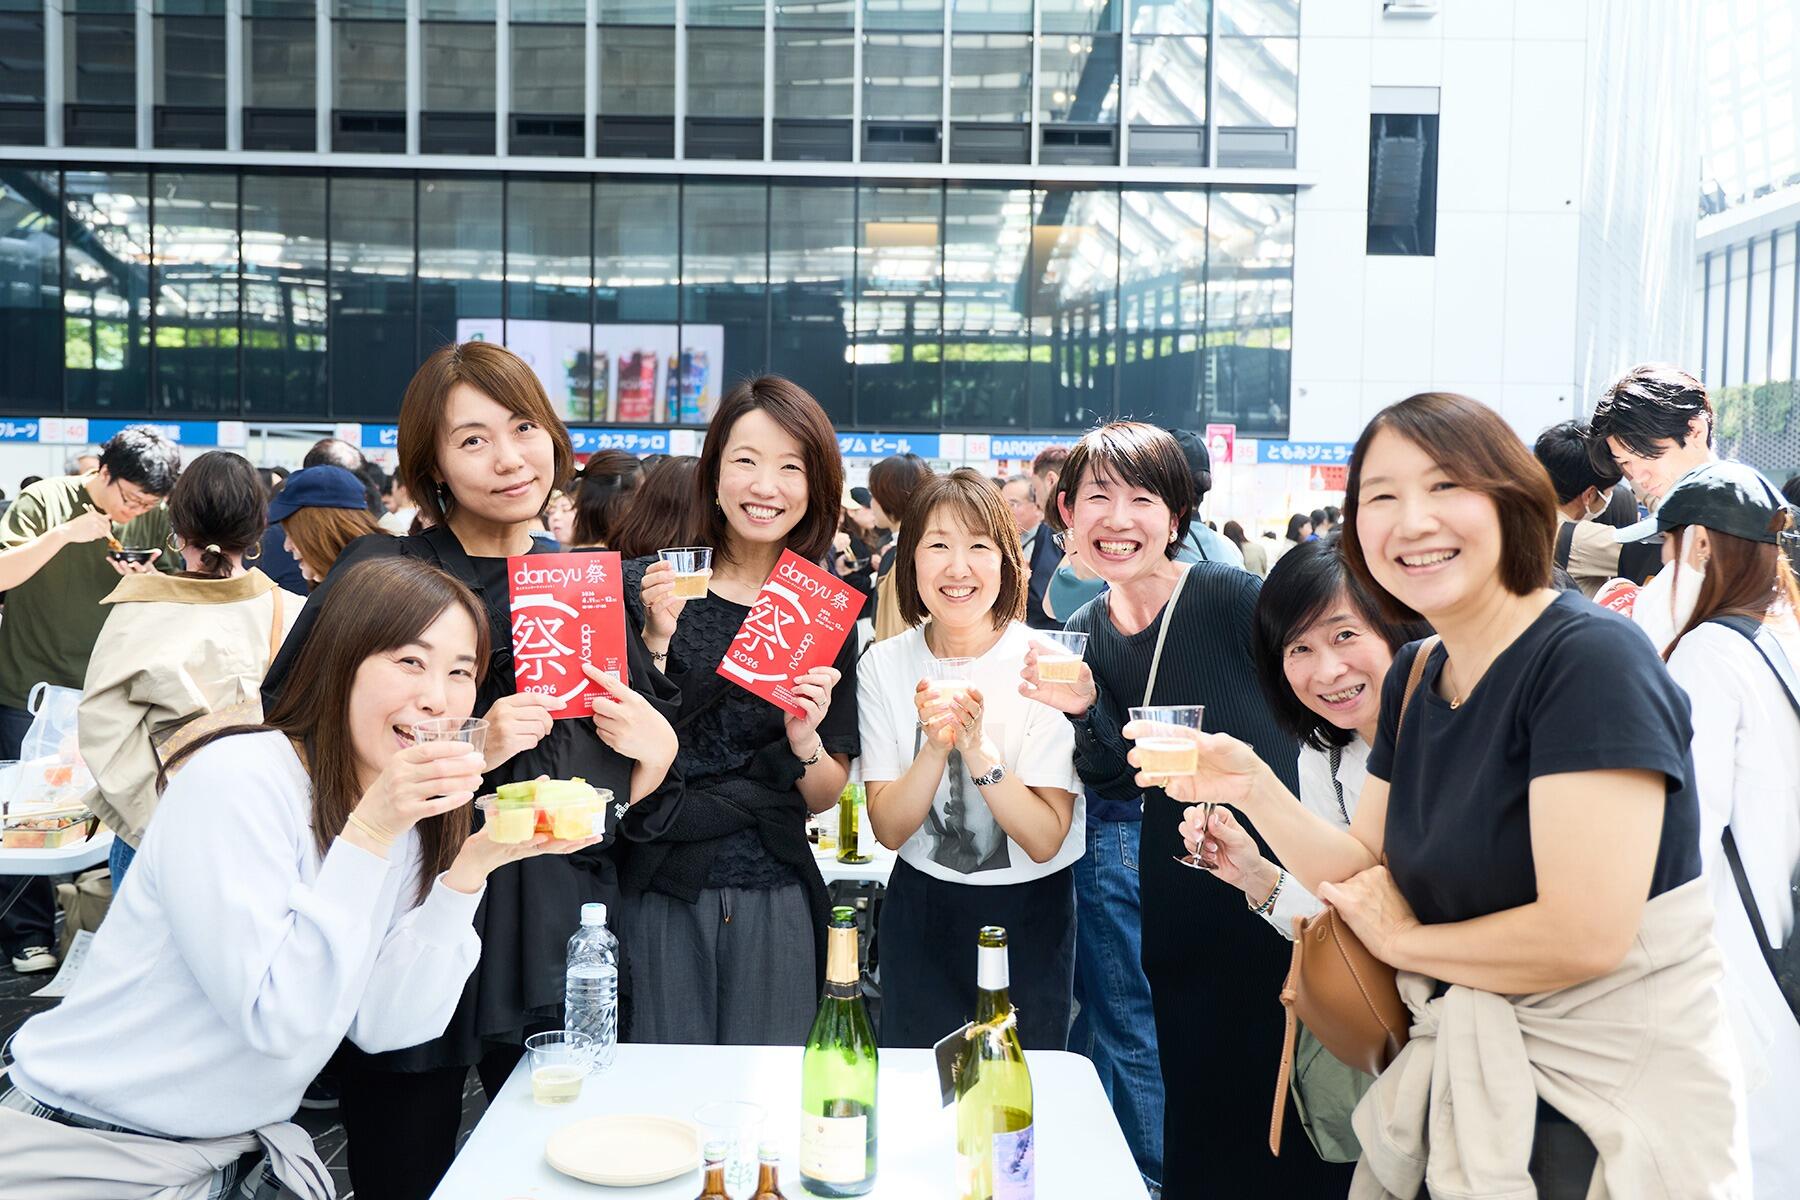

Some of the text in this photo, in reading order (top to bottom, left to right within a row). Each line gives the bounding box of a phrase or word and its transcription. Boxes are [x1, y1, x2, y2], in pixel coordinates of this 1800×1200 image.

[871, 438, 911, 454] ビール
[992, 441, 1053, 456] BAROK
[514, 562, 607, 588] dancyu 祭
[779, 561, 832, 599] dancyu
[830, 592, 849, 611] 祭
[512, 613, 576, 681] 祭
[578, 624, 596, 665] dancy
[734, 595, 796, 661] 祭
[732, 649, 759, 669] 2026
[789, 633, 815, 671] dancyu
